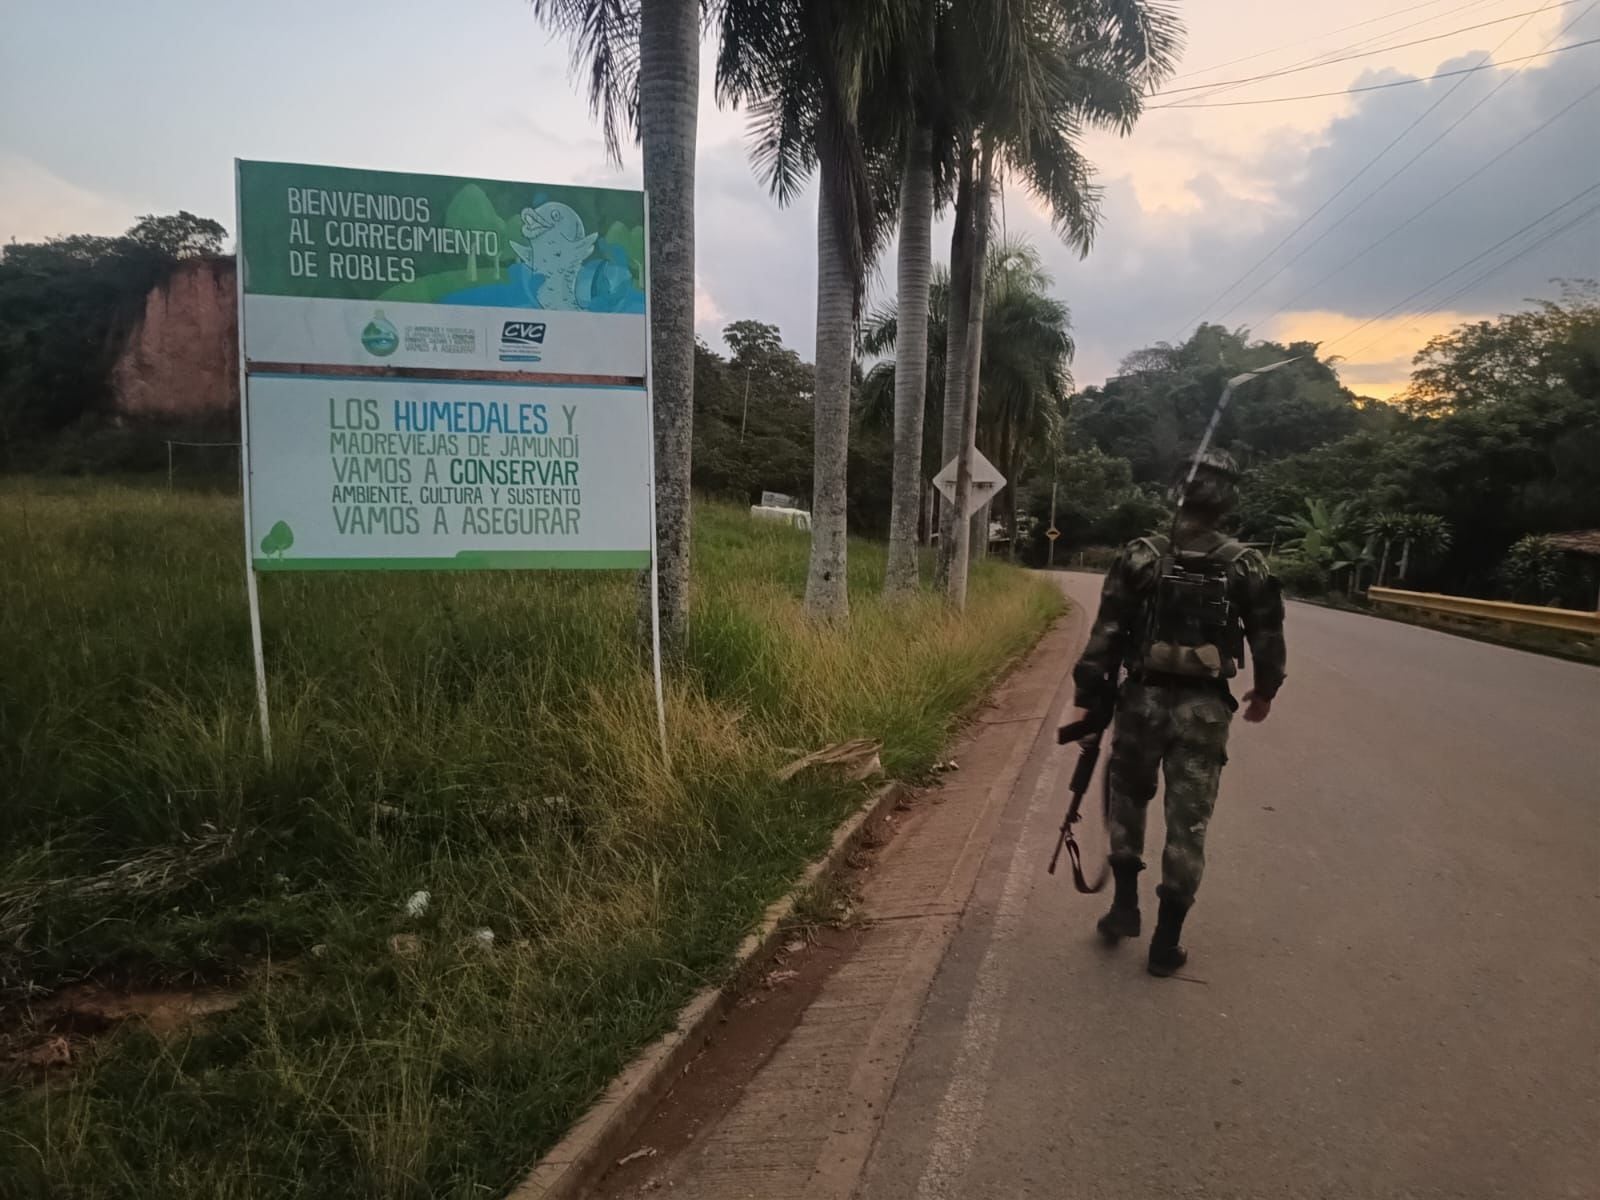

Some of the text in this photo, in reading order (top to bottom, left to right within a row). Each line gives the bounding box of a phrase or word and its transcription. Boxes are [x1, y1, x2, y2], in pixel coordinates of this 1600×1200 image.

[287, 187, 430, 223] BIENVENIDOS
[289, 218, 499, 257] AL CORREGIMIENTO
[289, 250, 416, 283] DE ROBLES
[505, 323, 544, 338] CVC
[329, 398, 577, 436] LOS HUMEDALES Y
[330, 432, 580, 459] MADREVIEJAS DE JAMUNDÍ
[332, 457, 579, 486] VAMOS A CONSERVAR
[420, 486, 483, 505] CULTURA
[491, 487, 499, 505] Y
[507, 487, 581, 506] SUSTENTO
[333, 506, 581, 536] VAMOS A ASEGURAR
